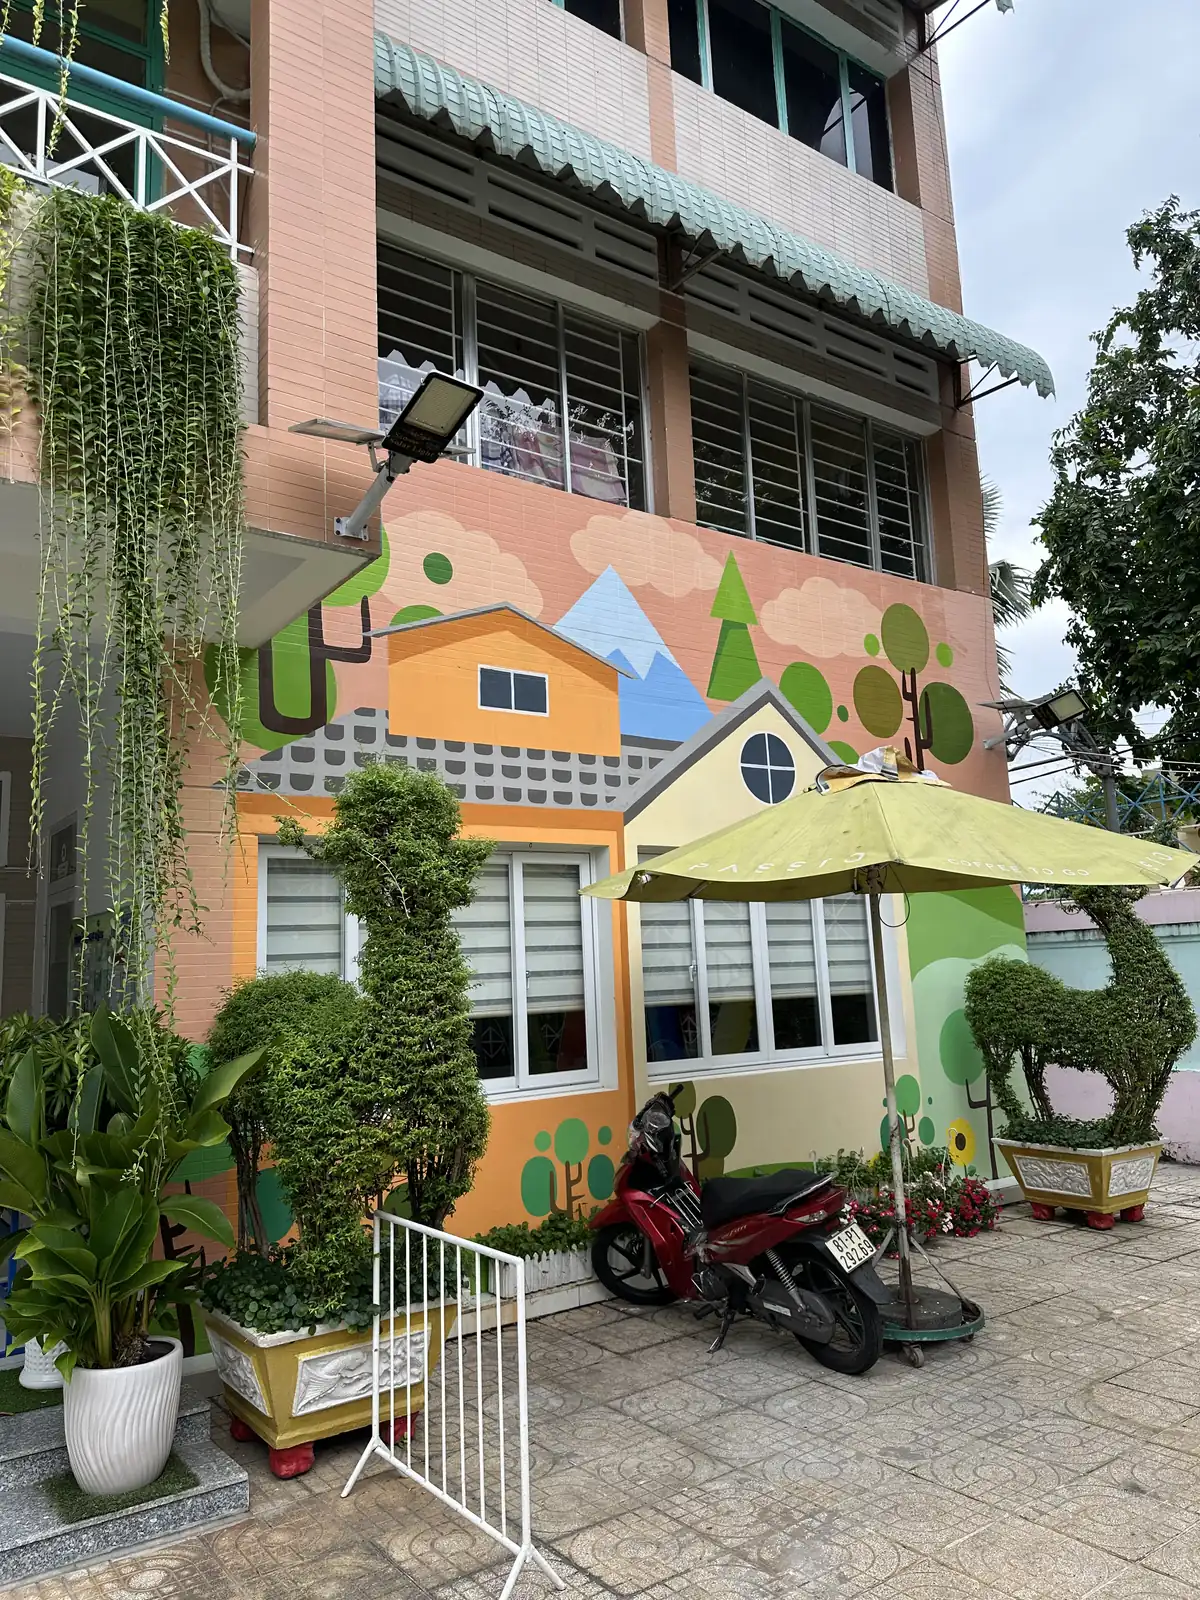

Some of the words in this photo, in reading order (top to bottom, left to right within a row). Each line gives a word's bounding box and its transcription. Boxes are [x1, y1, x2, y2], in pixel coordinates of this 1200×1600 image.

[688, 852, 866, 874] PASSIO
[947, 858, 1022, 873] COFFEE
[1028, 866, 1054, 876] TO
[1062, 868, 1090, 877] GO
[832, 1227, 861, 1253] 81-P1
[840, 1239, 875, 1270] 292.69
